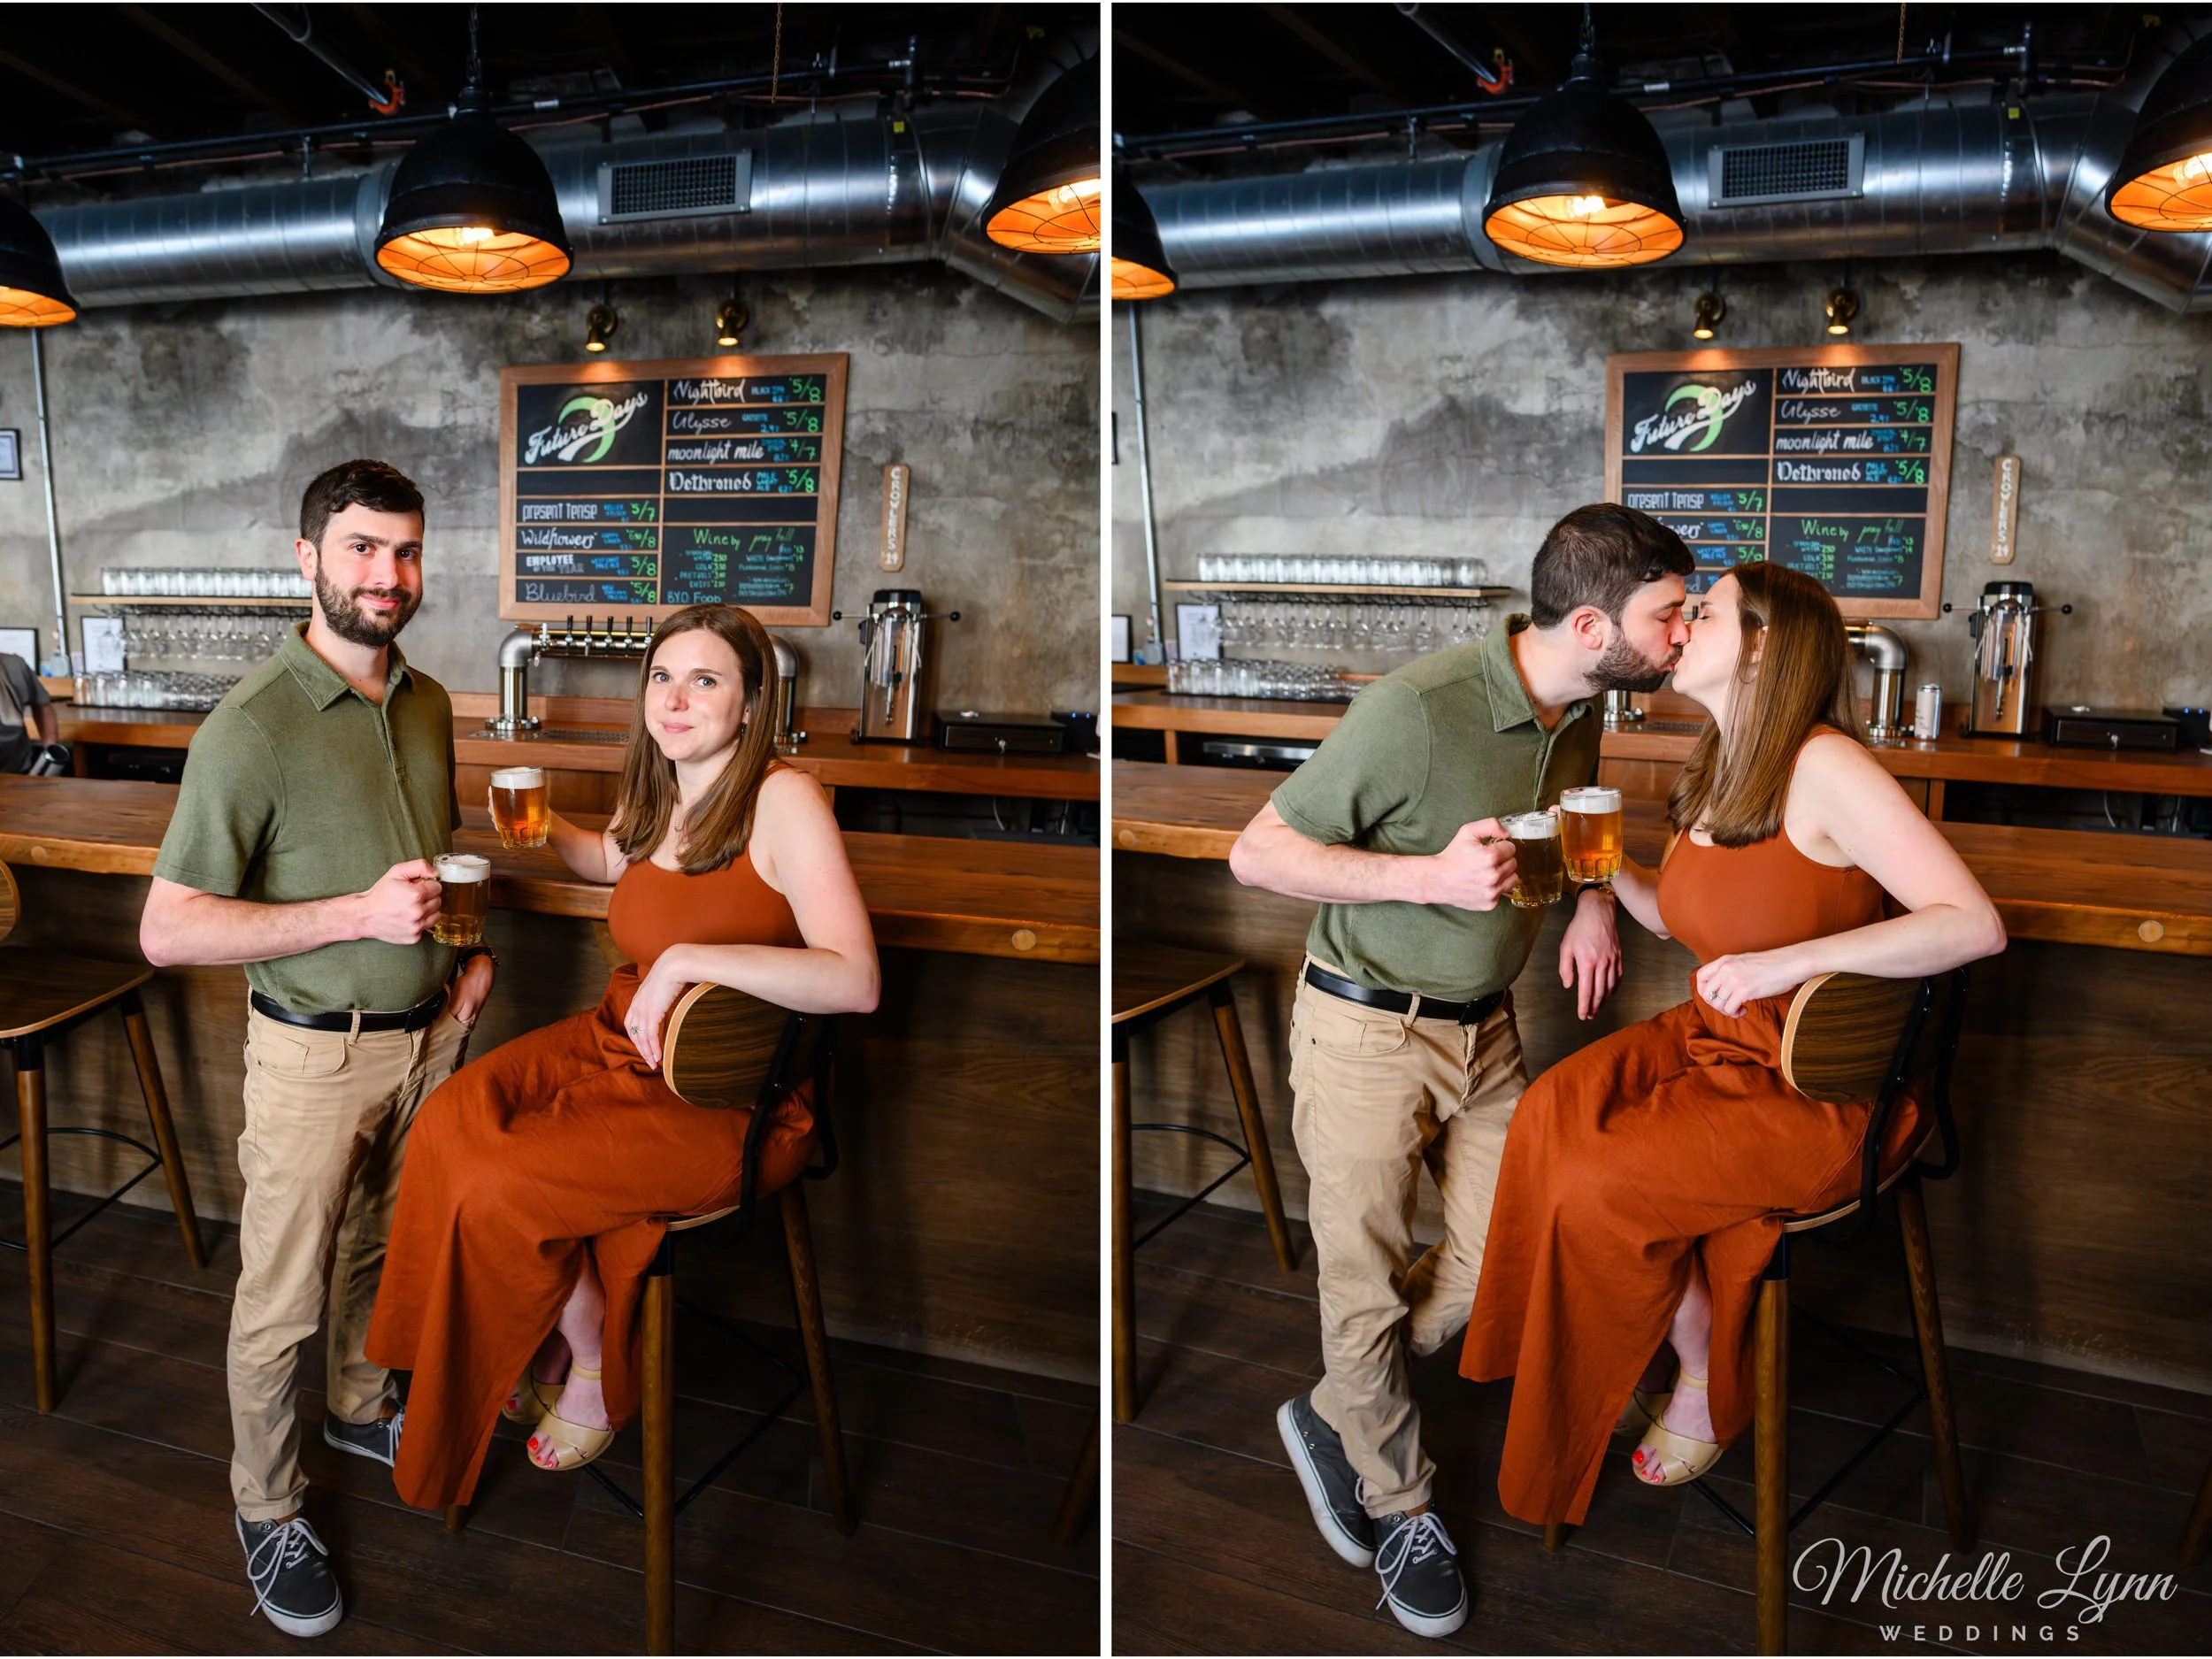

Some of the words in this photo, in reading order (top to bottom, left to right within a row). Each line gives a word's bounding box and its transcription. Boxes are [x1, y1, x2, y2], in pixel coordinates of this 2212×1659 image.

[673, 378, 747, 405] Nightbird
[1782, 367, 1855, 395] Nightbird
[525, 426, 589, 465] Future
[1631, 414, 1695, 453] Future
[1776, 429, 1840, 456] moonlight
[1843, 429, 1874, 449] mile
[668, 440, 731, 465] moonlight
[733, 441, 764, 459] mile
[669, 472, 752, 492] Dethroned
[1777, 461, 1861, 482] Dethroned
[694, 528, 729, 546] Wine
[730, 535, 741, 551] by
[1801, 518, 1837, 536] Wine
[1839, 526, 1849, 542] by
[526, 554, 574, 567] EMPLOYEE
[525, 582, 596, 603] Bluebird
[667, 590, 689, 603] BYO
